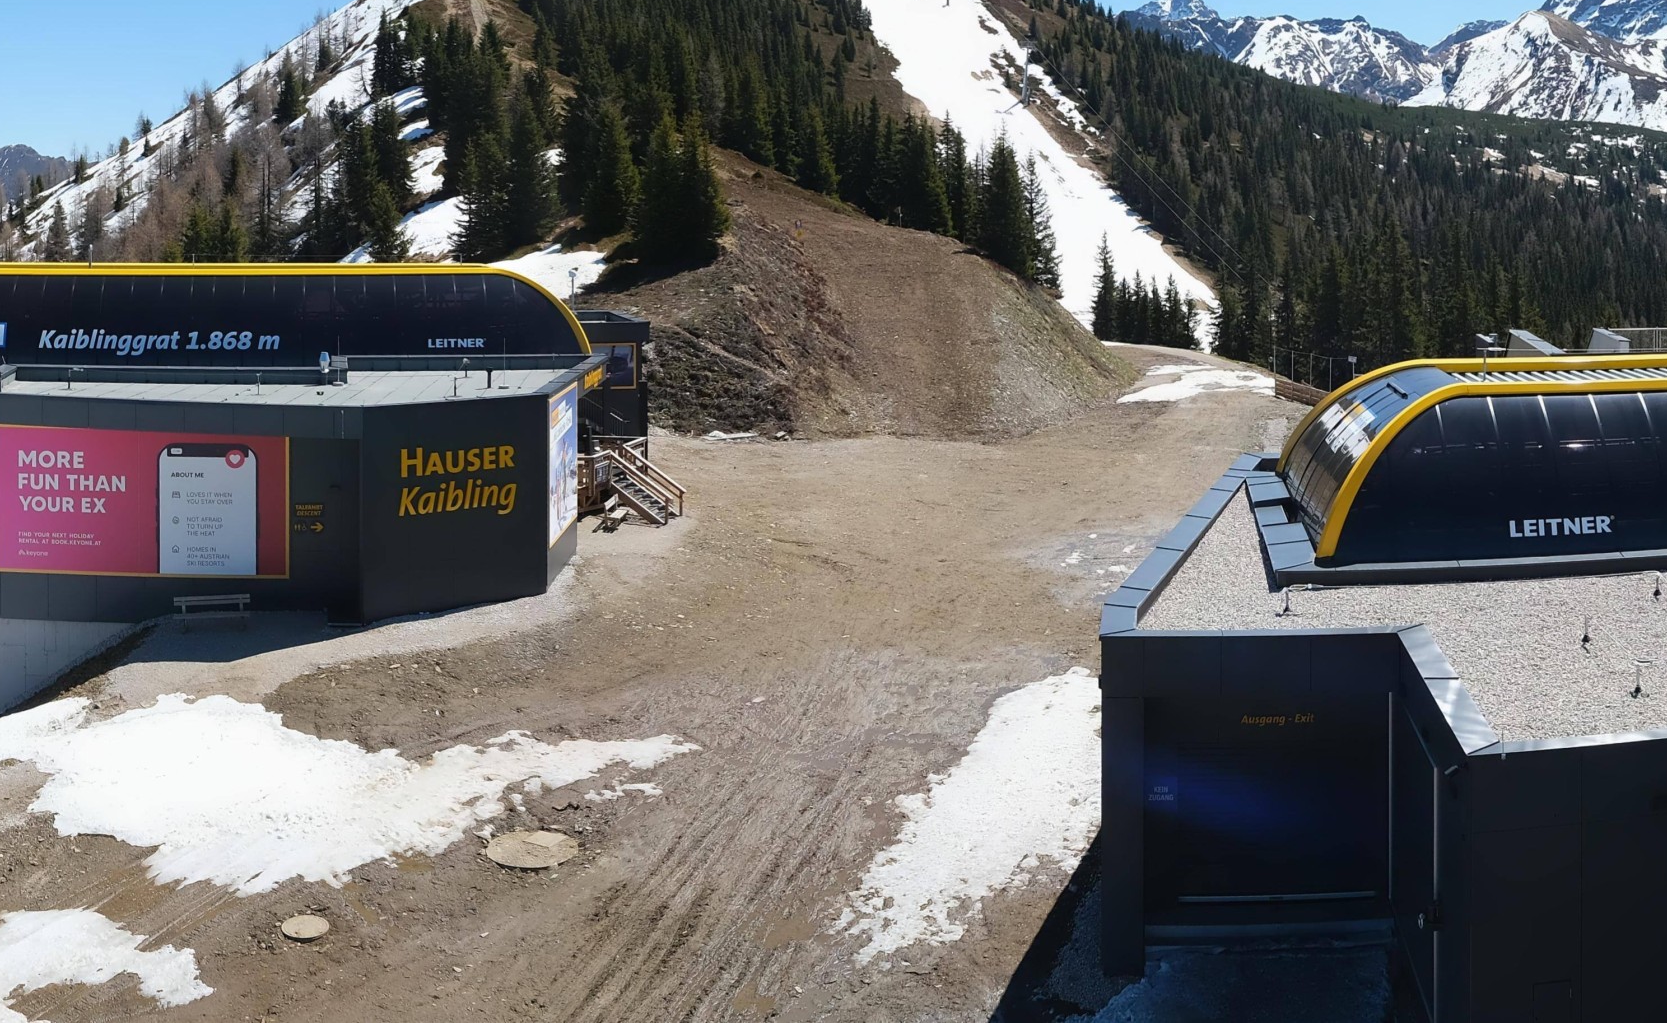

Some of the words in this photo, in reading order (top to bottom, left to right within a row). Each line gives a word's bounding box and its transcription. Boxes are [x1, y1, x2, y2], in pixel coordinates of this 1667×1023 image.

[38, 328, 181, 356] Kaiblinggrat
[185, 330, 252, 350] 1.868
[257, 334, 281, 350] m
[427, 338, 485, 349] LEITNER
[17, 450, 84, 468] MORE
[400, 444, 516, 478] HAUSER
[17, 473, 59, 491] FUN
[66, 474, 126, 492] THAN
[18, 495, 75, 514] YOUR
[81, 497, 106, 514] EX
[398, 479, 517, 517] Kaibling
[1509, 516, 1613, 538] LEITNER
[1240, 714, 1286, 726] Ausgang
[1294, 713, 1315, 723] Exit
[1153, 786, 1169, 794] KEIN
